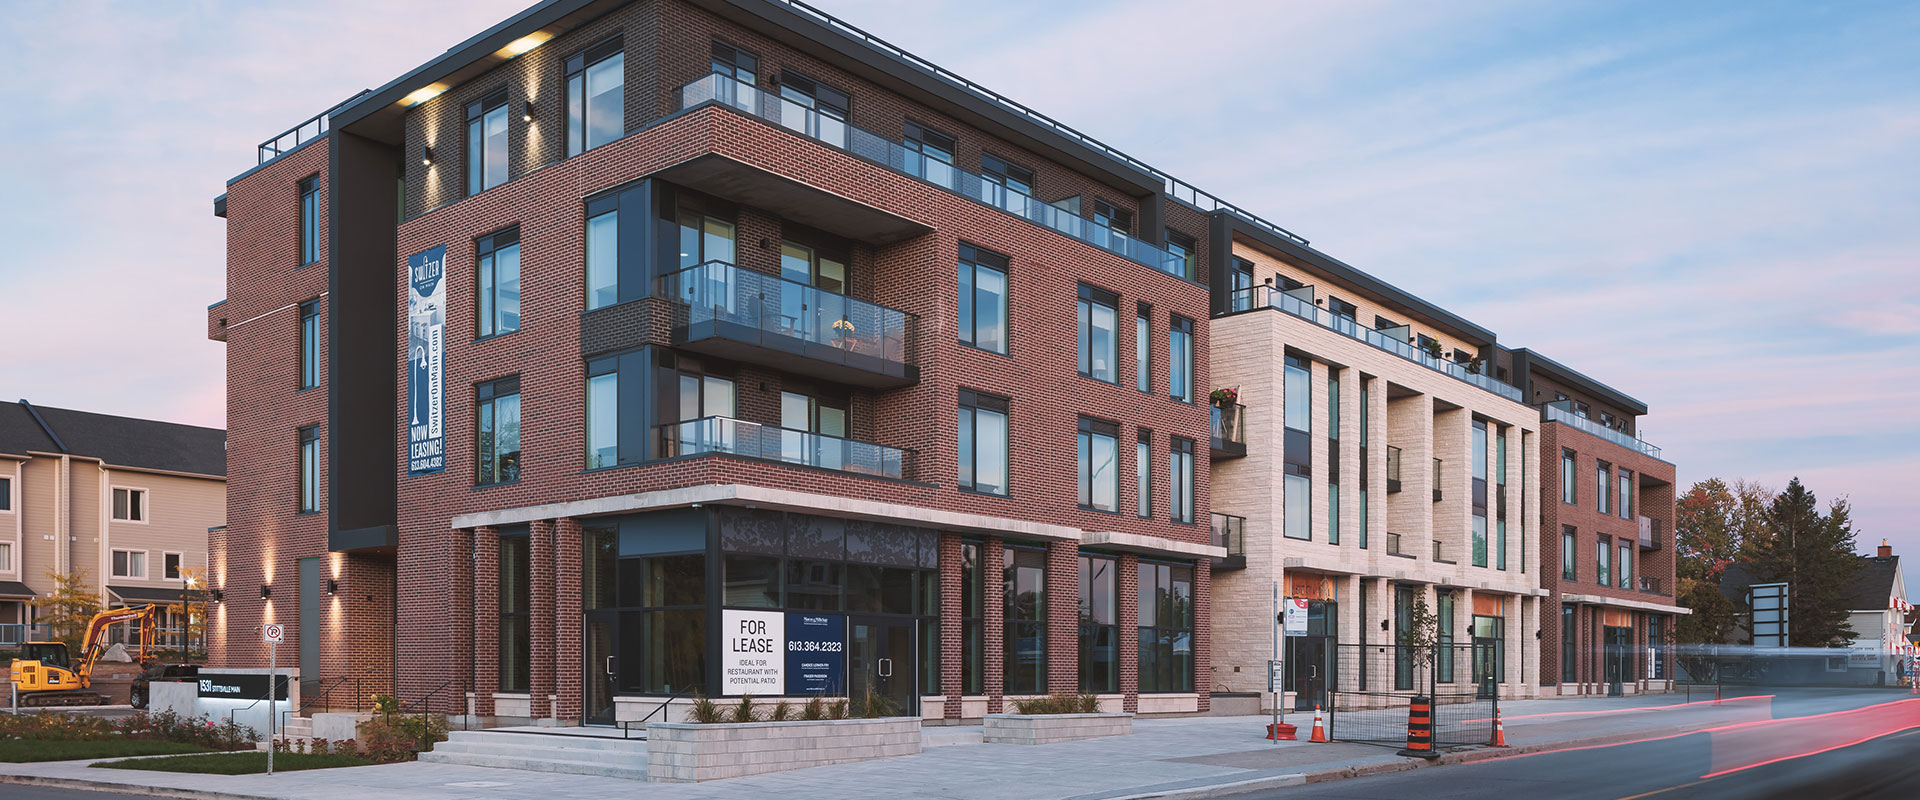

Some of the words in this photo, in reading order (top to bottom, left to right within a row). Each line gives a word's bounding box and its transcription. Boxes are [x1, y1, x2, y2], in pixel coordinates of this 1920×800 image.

[411, 424, 428, 442] NOW
[411, 438, 442, 459] LEASING!
[740, 620, 766, 635] FOR
[733, 638, 774, 653] LEASE
[788, 640, 842, 652] 613.364.2323
[200, 680, 211, 692] 1531
